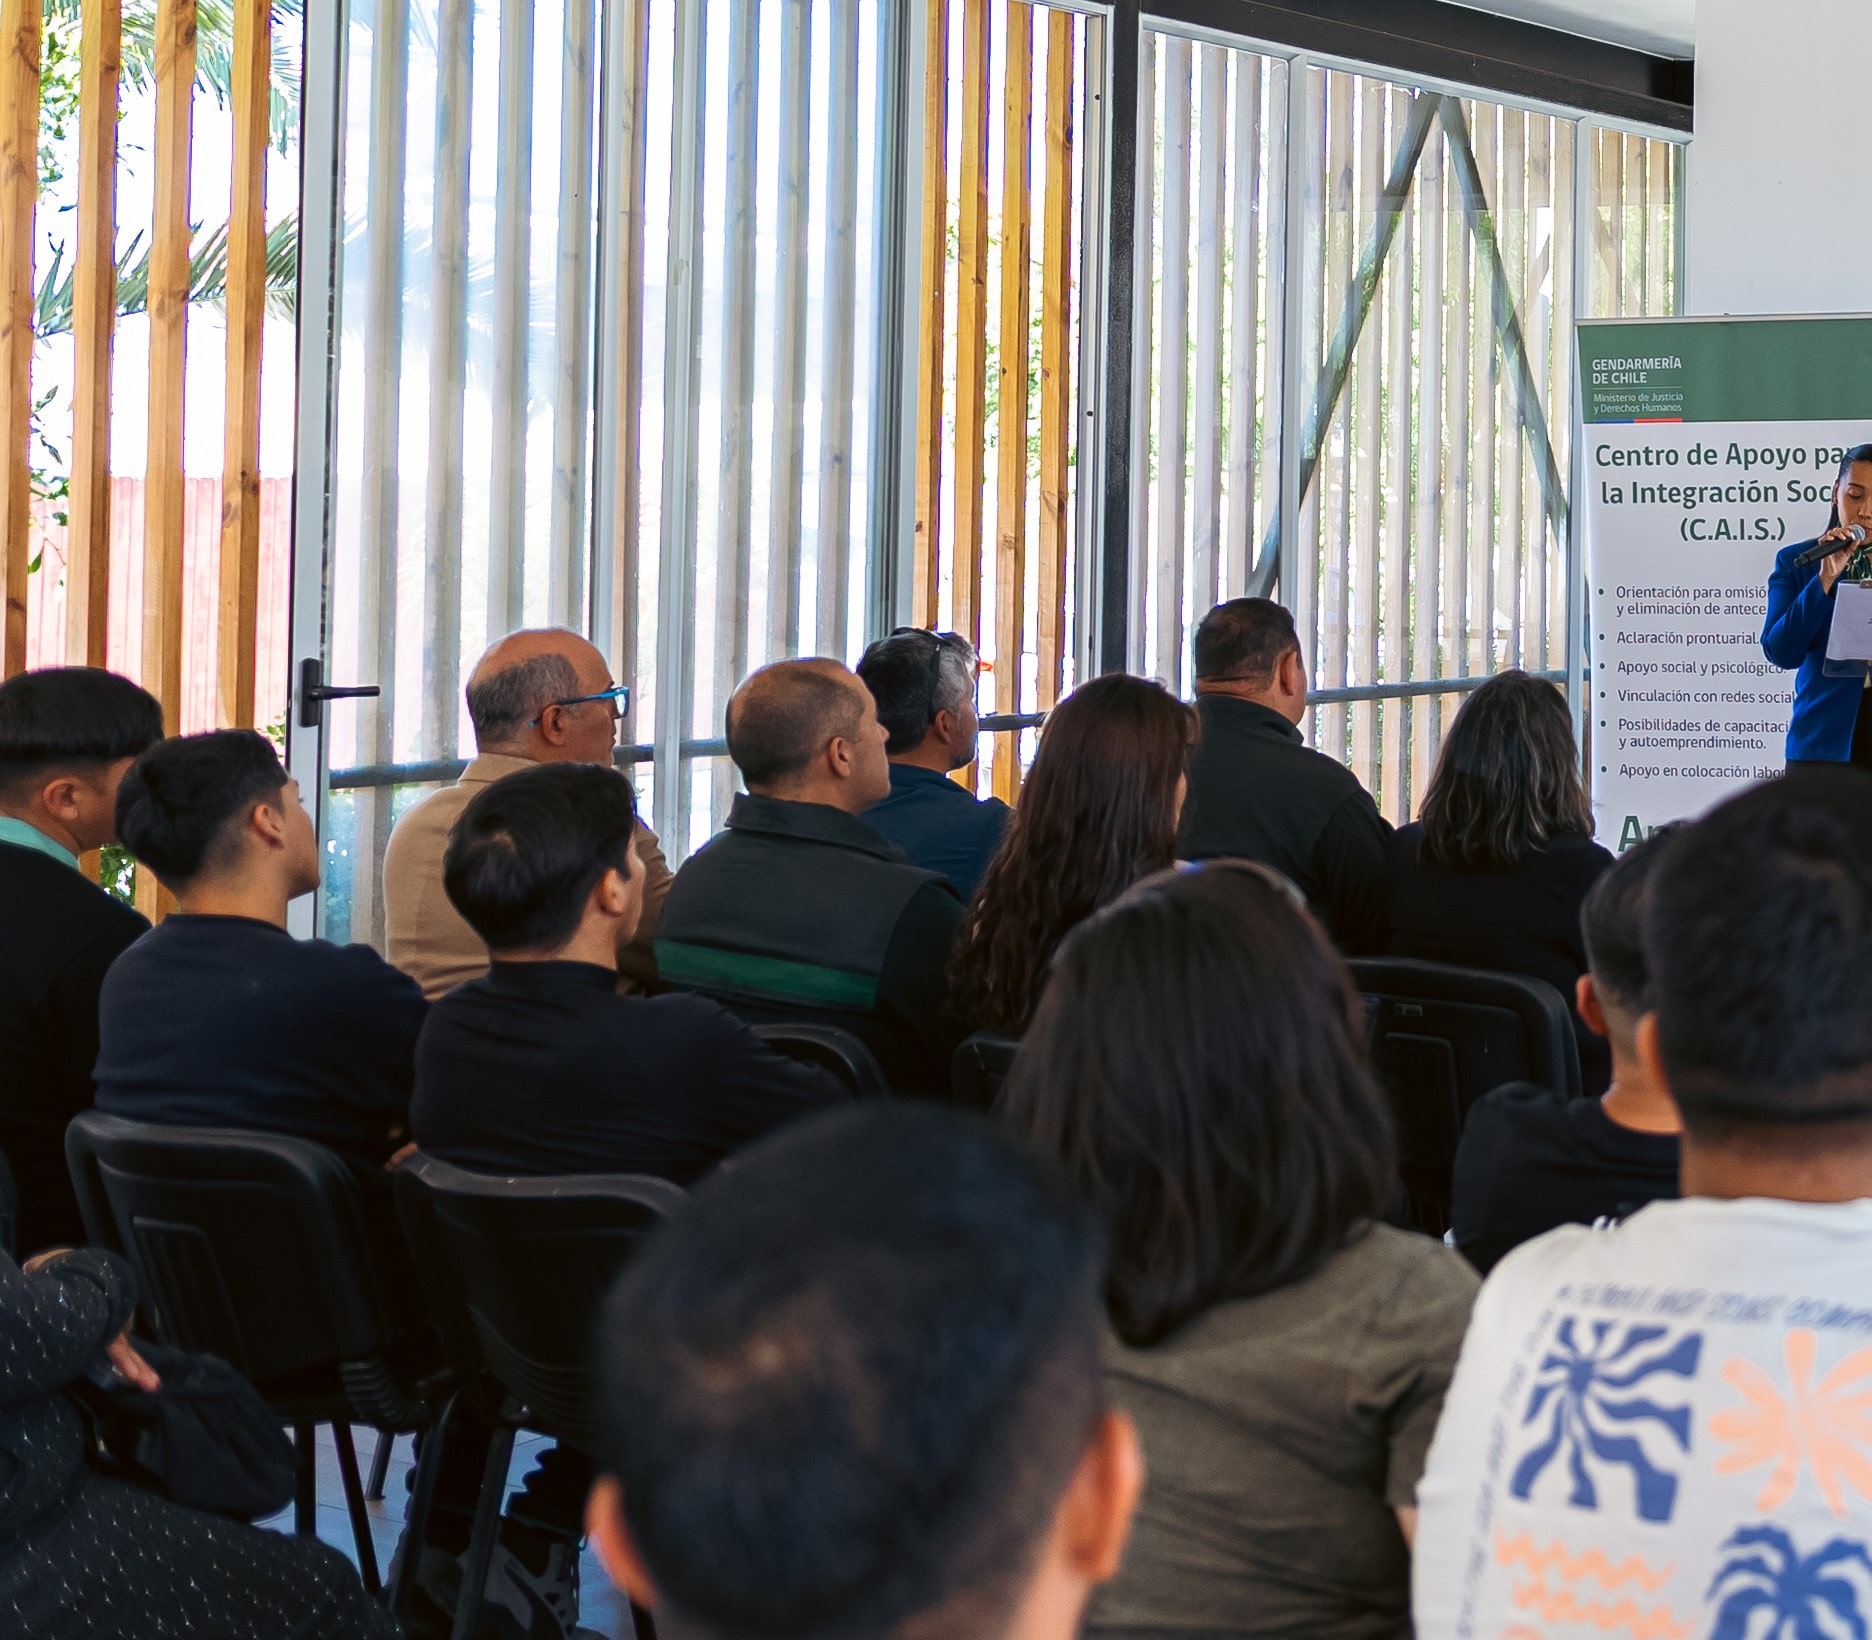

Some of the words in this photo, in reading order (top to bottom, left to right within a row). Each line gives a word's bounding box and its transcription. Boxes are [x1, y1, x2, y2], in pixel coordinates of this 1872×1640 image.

[1592, 355, 1682, 371] GENDARMERÍA
[1593, 373, 1608, 384] DE
[1611, 372, 1648, 384] CHILE
[1594, 393, 1636, 402] Ministerio
[1638, 393, 1649, 402] de
[1651, 392, 1684, 402] Justicia
[1593, 406, 1600, 416] y
[1601, 404, 1640, 413] Derechos
[1641, 403, 1682, 412] Humanos
[1596, 444, 1679, 466] Centro
[1686, 443, 1718, 465] de
[1725, 444, 1807, 470] Apoyo
[1814, 447, 1854, 470] pa
[1602, 482, 1624, 504] la
[1632, 480, 1779, 509] Integración
[1787, 479, 1832, 503] Soc
[1680, 518, 1786, 542] (C.A.I.S.)
[1616, 585, 1690, 599] Orientación
[1693, 588, 1722, 602] para
[1724, 585, 1767, 599] omisió
[1616, 605, 1625, 617] y
[1627, 602, 1701, 616] eliminación
[1704, 603, 1721, 615] de
[1724, 604, 1767, 615] antece
[1617, 631, 1683, 645] Aclaración
[1686, 631, 1760, 647] prontuarial.
[1618, 661, 1658, 675] Apoyo
[1662, 660, 1697, 674] social
[1700, 664, 1708, 676] y
[1618, 689, 1690, 703] Vinculación
[1694, 692, 1718, 703] con
[1721, 690, 1755, 703] redes
[1758, 690, 1795, 703] social
[1618, 718, 1701, 732] Posibilidades
[1704, 719, 1721, 732] de
[1724, 719, 1788, 735] capacitaci
[1619, 738, 1627, 750] y
[1629, 736, 1767, 750] autoemprendimiento.
[1619, 764, 1660, 779] Apoyo
[1664, 767, 1678, 777] en
[1681, 764, 1750, 778] colocación
[1752, 765, 1786, 779] labor
